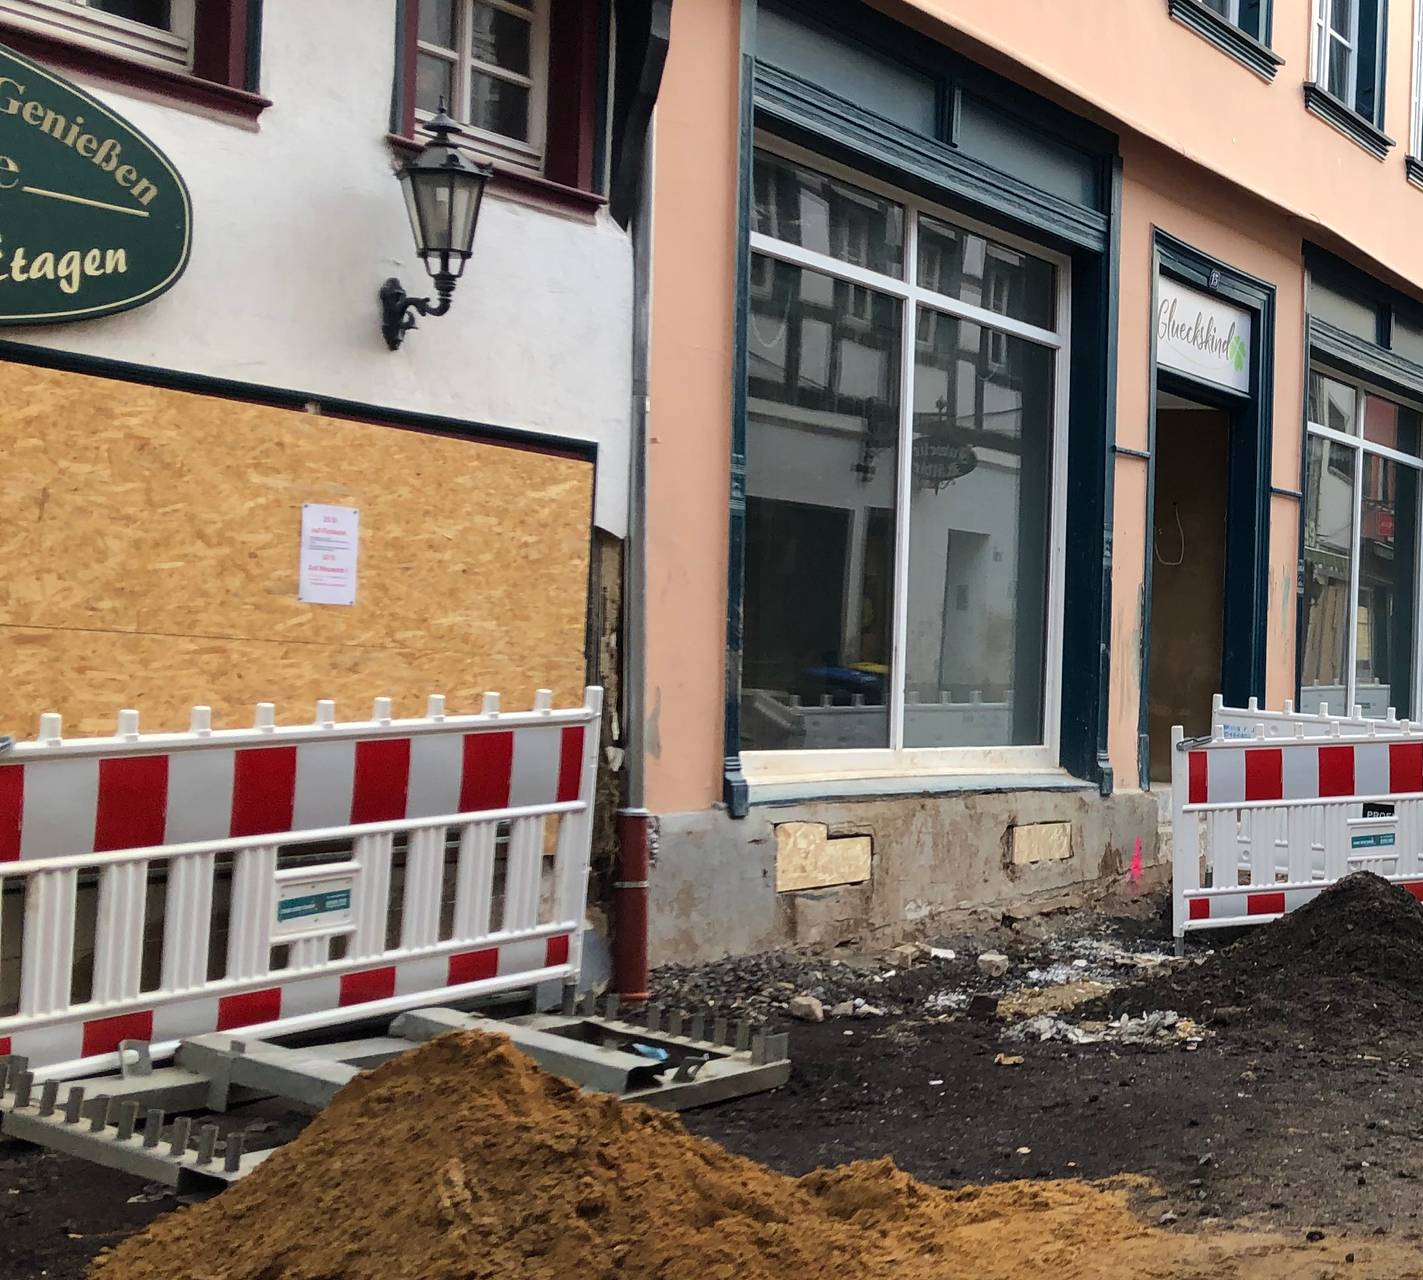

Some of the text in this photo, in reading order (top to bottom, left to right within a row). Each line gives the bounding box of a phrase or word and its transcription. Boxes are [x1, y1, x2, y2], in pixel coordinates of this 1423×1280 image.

[0, 76, 159, 206] Genießen
[0, 237, 128, 294] tagen
[1157, 297, 1236, 361] Glueckskind
